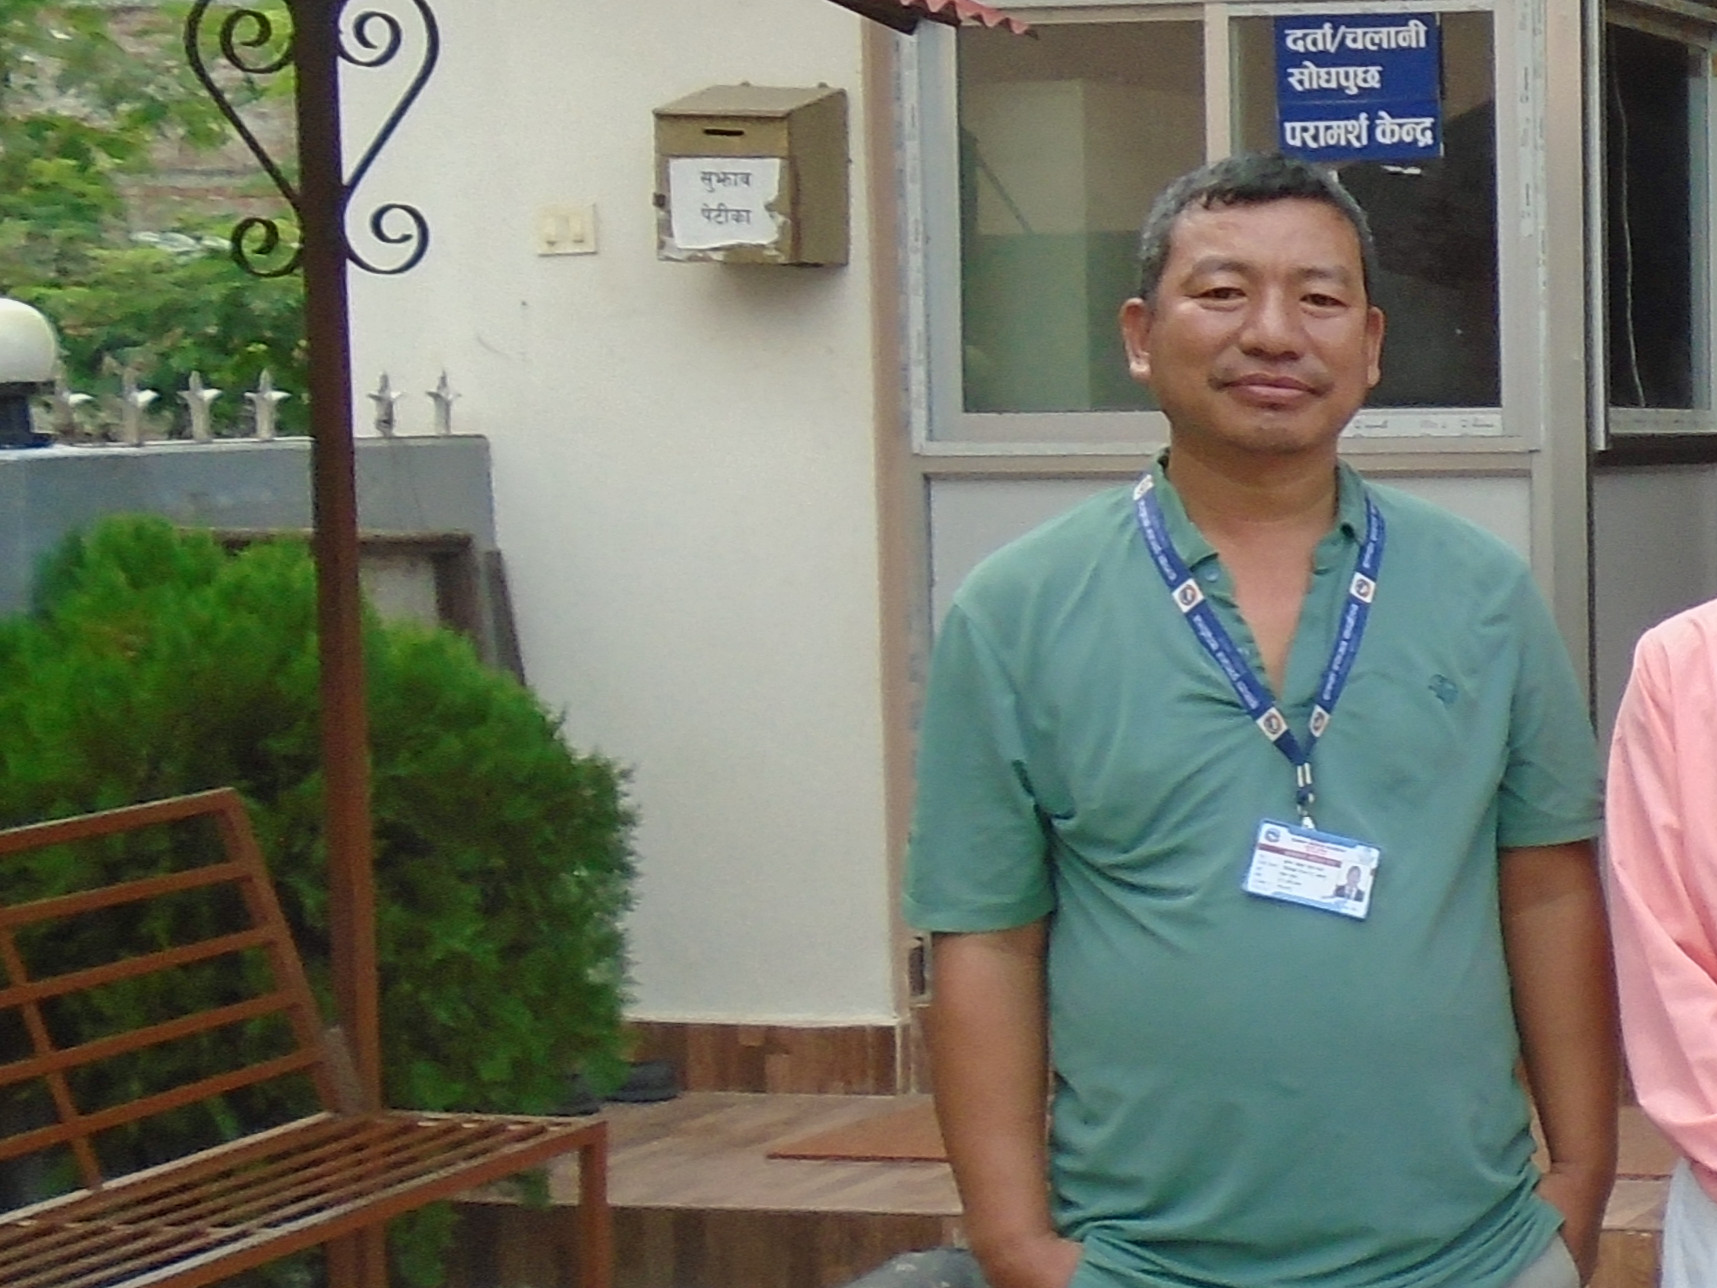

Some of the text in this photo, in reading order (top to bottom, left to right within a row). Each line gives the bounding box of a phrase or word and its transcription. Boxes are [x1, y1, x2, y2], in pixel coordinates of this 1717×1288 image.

[1284, 19, 1428, 53] दर्ता/चलानी
[1283, 111, 1435, 149] परामर्श केन्द्र
